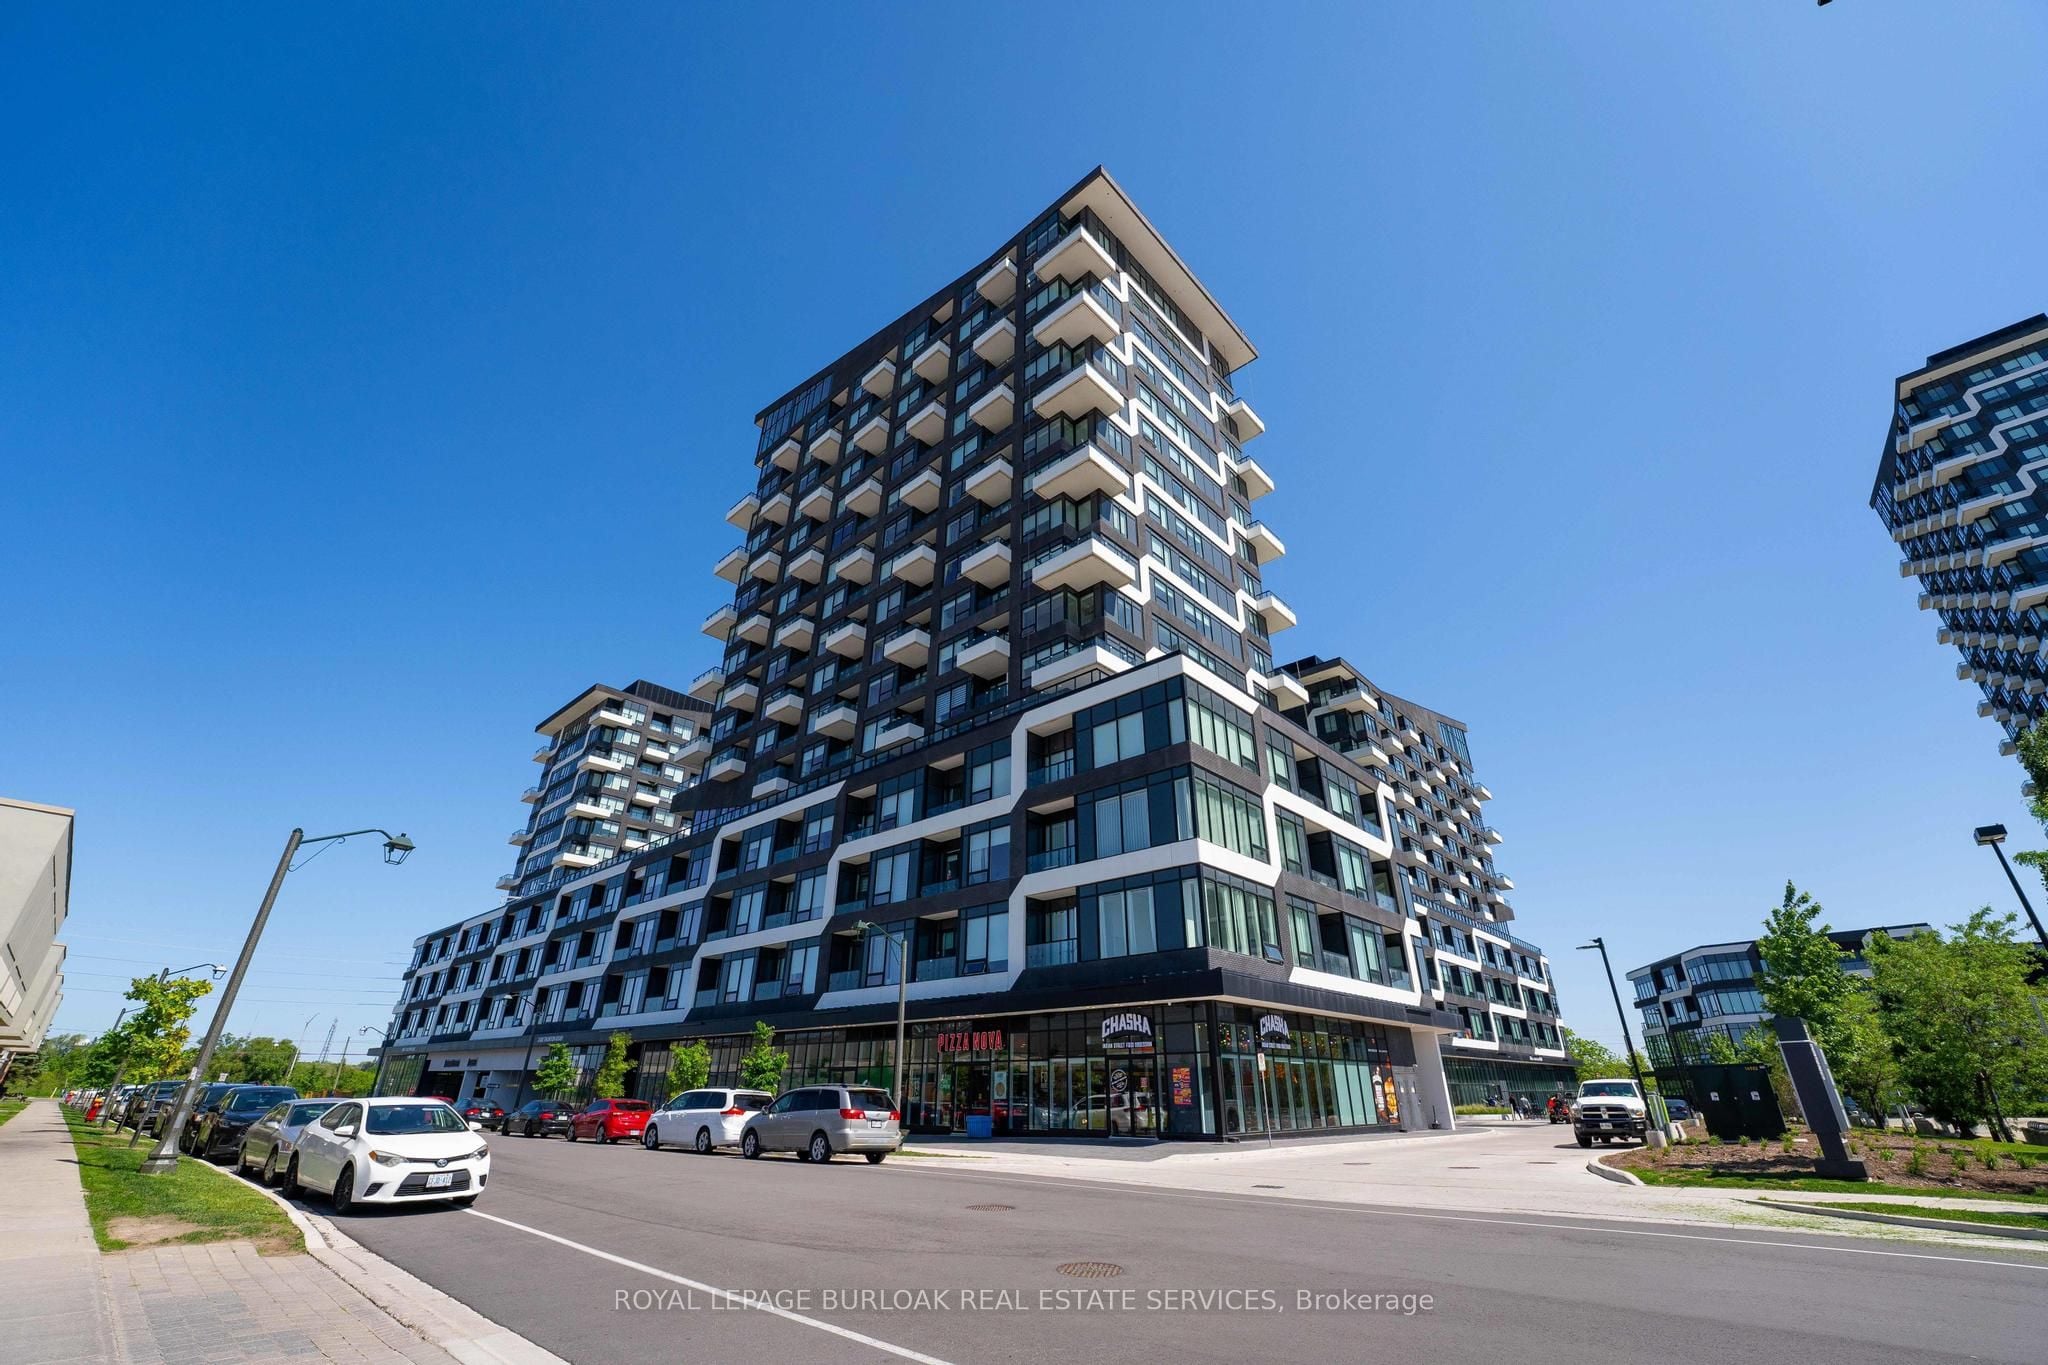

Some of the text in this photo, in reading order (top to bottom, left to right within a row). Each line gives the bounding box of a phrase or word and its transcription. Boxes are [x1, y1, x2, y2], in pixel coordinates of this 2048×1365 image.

[1102, 1013, 1152, 1038] CHASKA
[1260, 1014, 1290, 1039] CHASKA
[937, 1030, 1003, 1053] PIZZA NOVA
